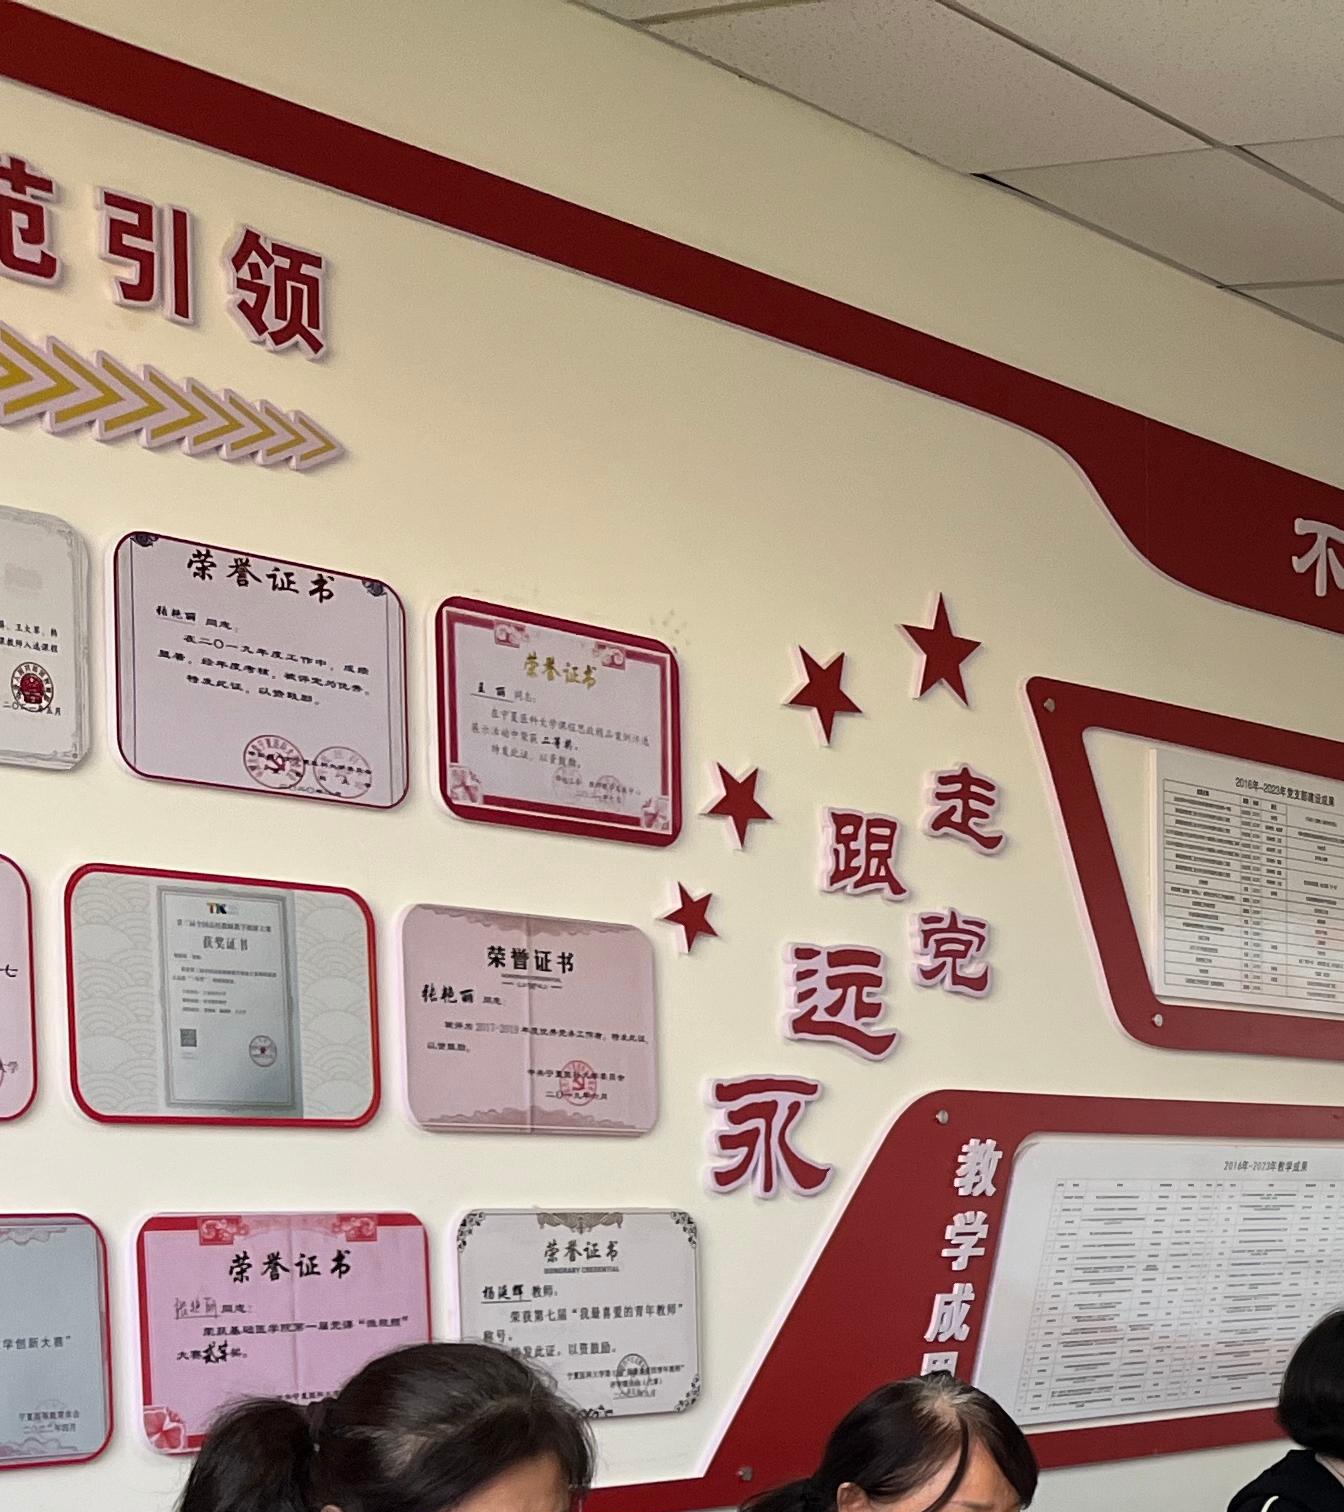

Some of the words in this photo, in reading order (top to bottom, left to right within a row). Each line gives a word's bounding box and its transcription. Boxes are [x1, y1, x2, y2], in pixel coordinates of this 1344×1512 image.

[187, 549, 335, 603] 荣誉证书
[524, 651, 597, 689] 荣誉证书
[487, 945, 574, 974] 荣誉证书
[229, 1249, 352, 1283] 荣誉证书
[544, 1239, 619, 1263] 荣誉证书
